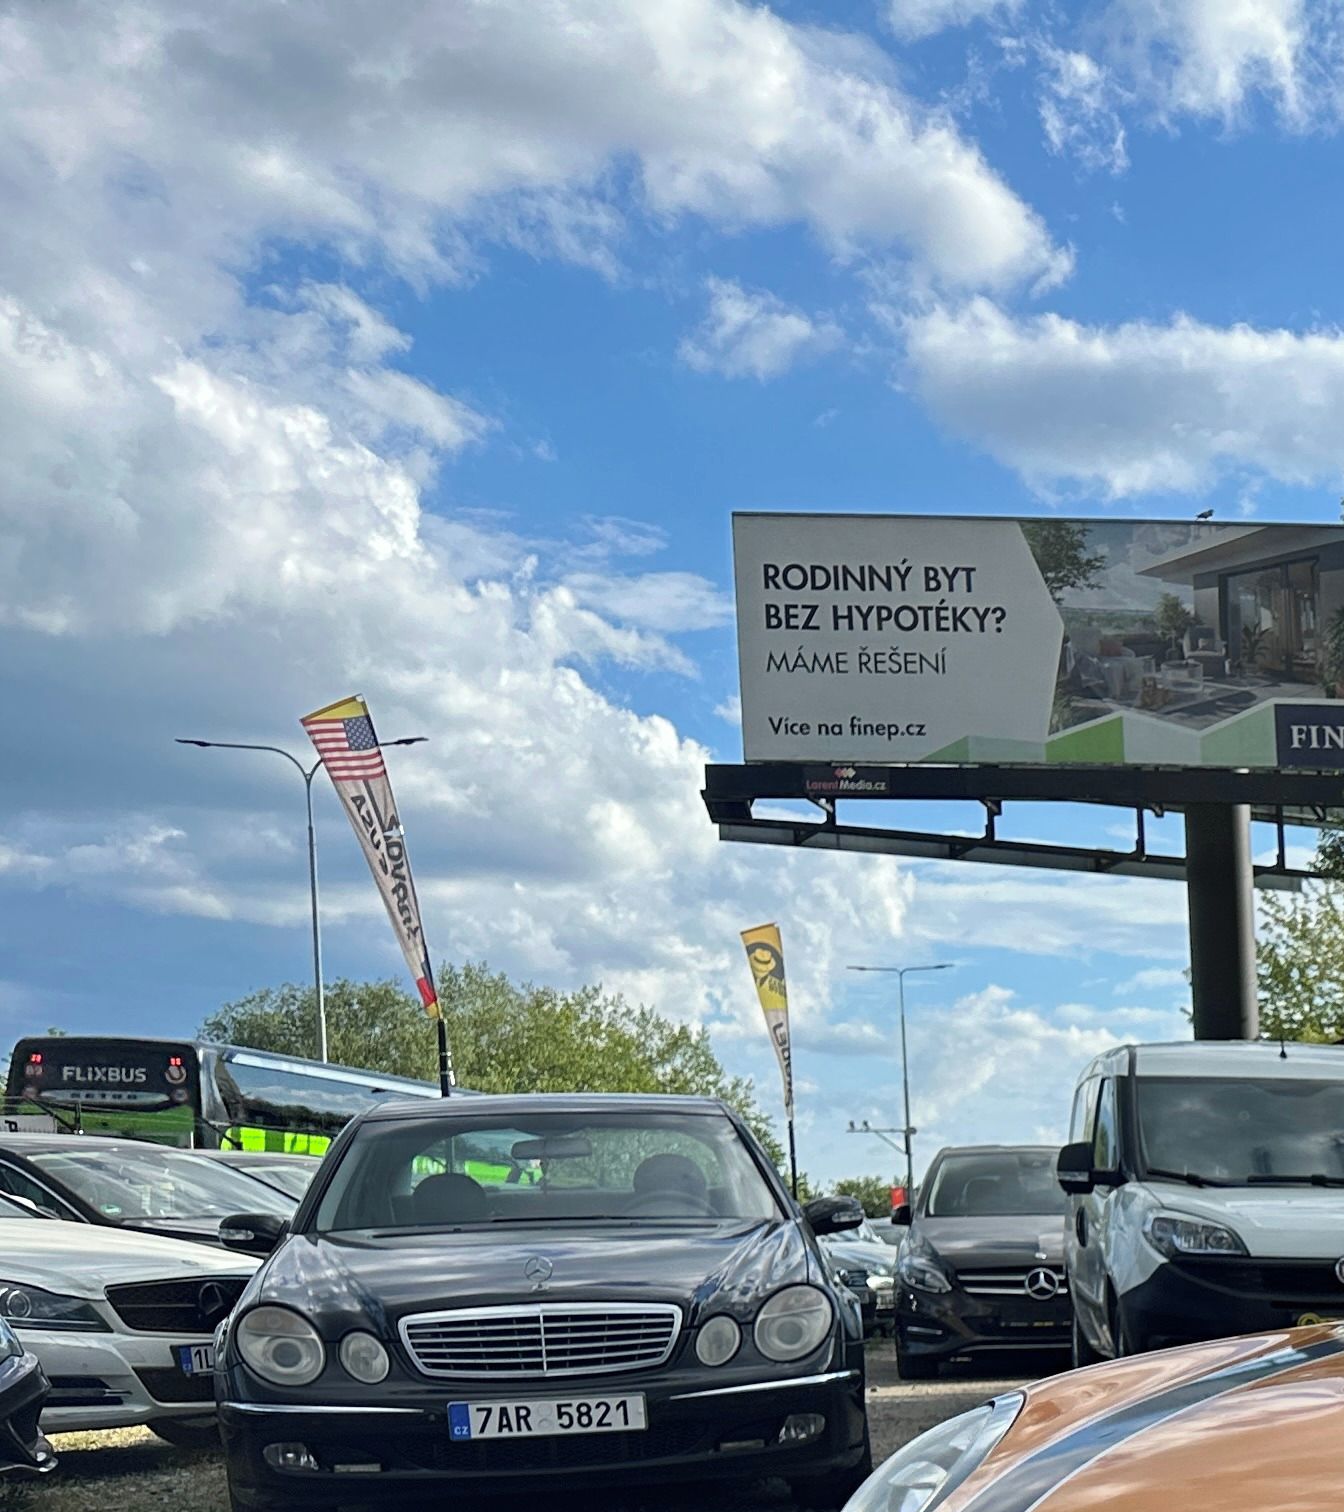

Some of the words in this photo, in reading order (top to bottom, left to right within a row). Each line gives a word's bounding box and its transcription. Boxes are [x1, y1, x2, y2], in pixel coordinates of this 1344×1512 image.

[762, 558, 913, 592] RODINNÝ
[924, 566, 977, 593] BYT
[764, 603, 821, 631] BEZ
[831, 598, 1007, 633] HYPOTÉKY?
[766, 645, 849, 674] MÁME
[858, 645, 948, 675] ŘEŠENÍ
[768, 716, 811, 736] Více
[817, 722, 843, 736] na
[849, 715, 927, 742] finep.cz
[453, 1426, 469, 1436] CZ
[475, 1405, 533, 1435] 7AR
[556, 1399, 630, 1430] 5821
